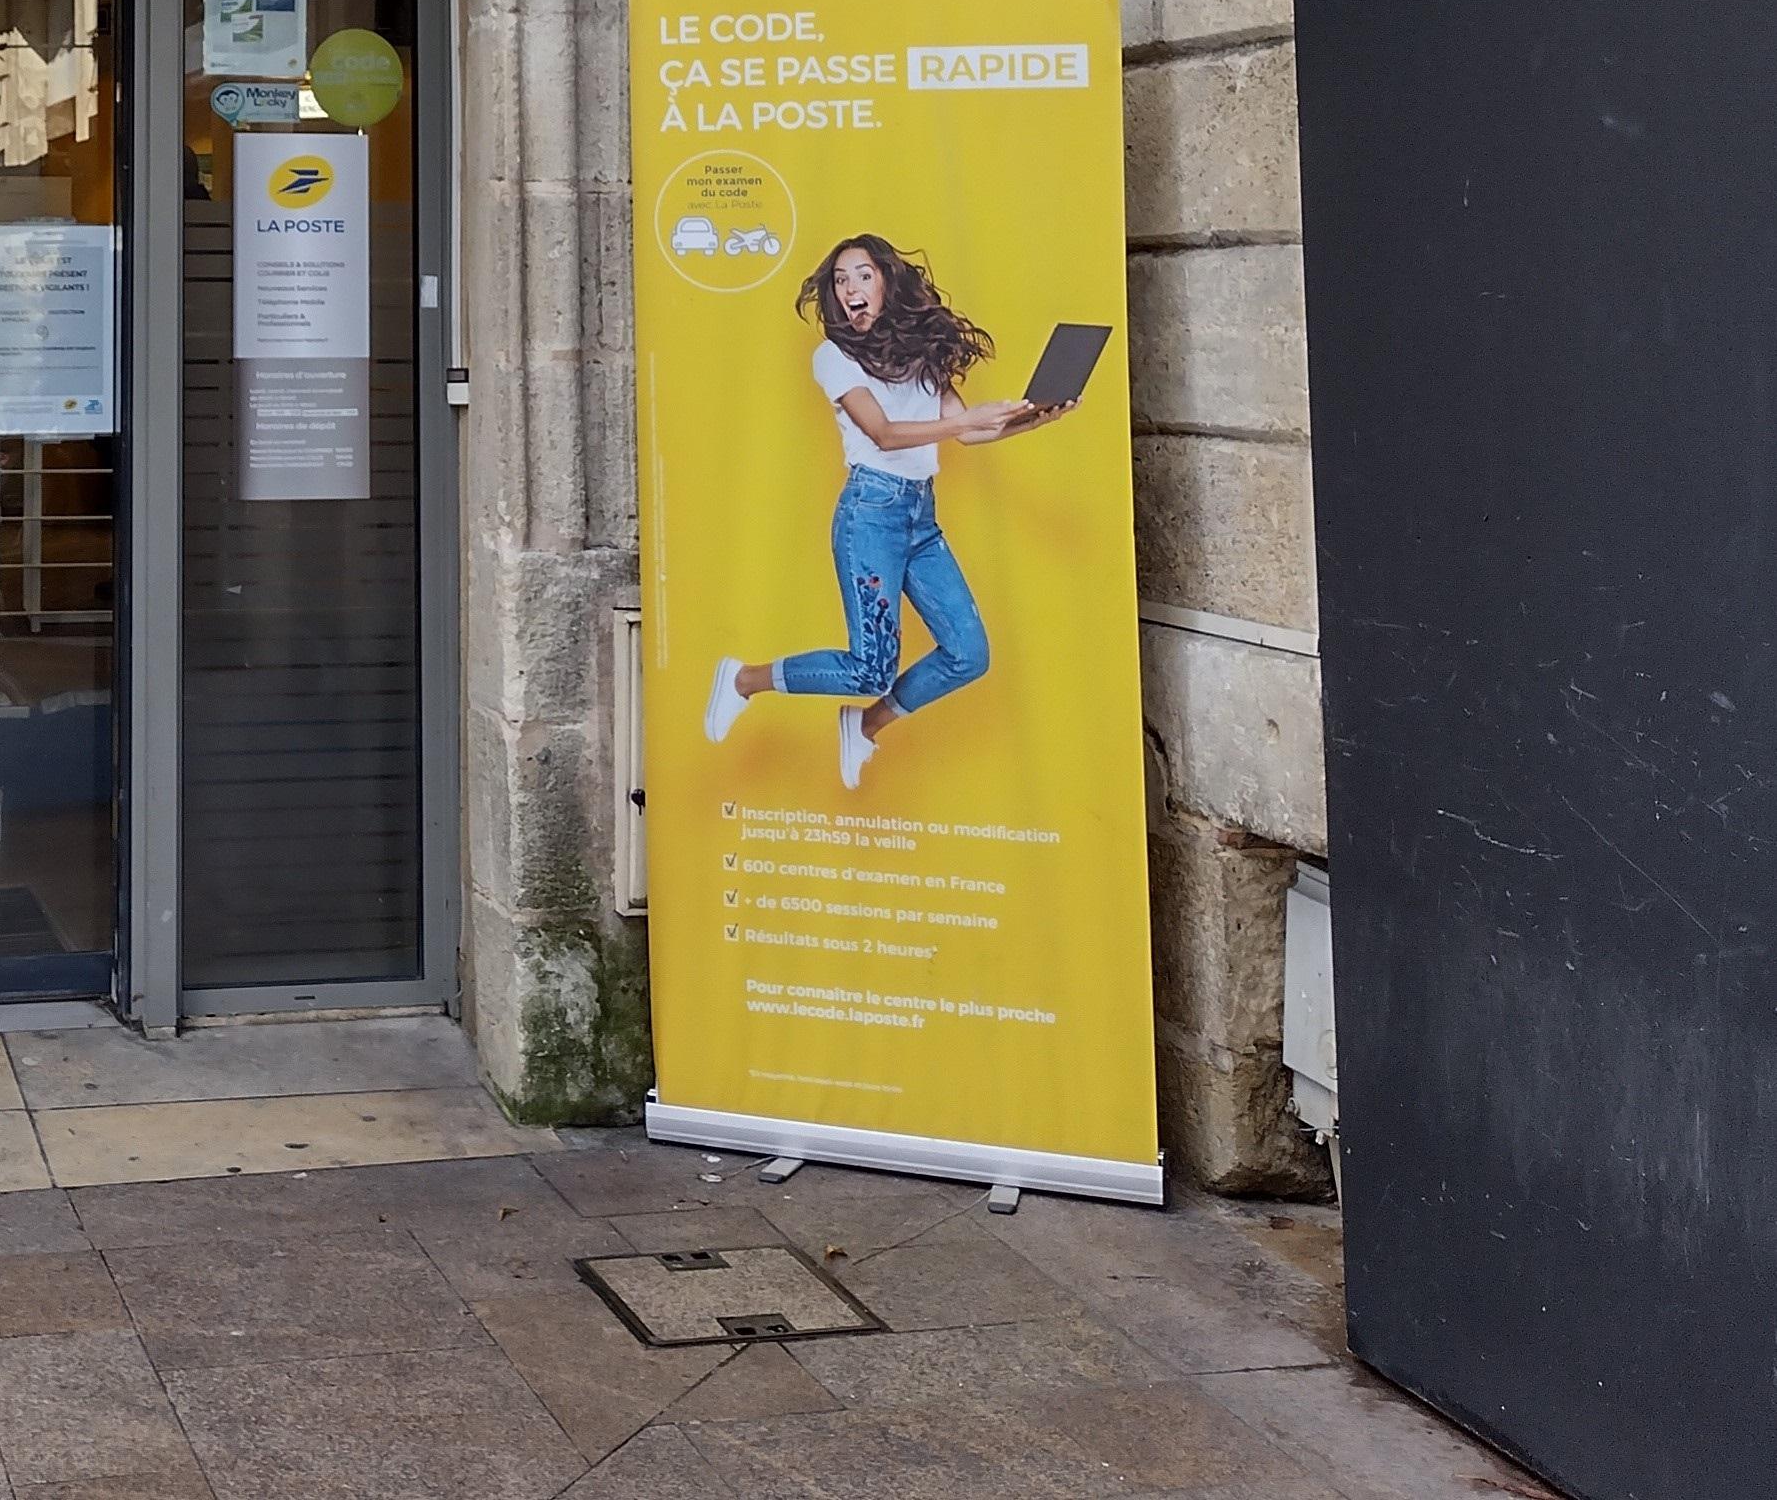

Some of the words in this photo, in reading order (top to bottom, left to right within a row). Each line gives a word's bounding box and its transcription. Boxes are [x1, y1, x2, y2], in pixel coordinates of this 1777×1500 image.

[659, 15, 701, 45] LE
[709, 11, 826, 44] CODE,
[658, 58, 713, 97] ÇA
[719, 57, 767, 87] SE
[776, 53, 898, 86] PASSE
[919, 51, 1080, 83] RAPIDE
[246, 87, 296, 100] Monkey
[253, 98, 287, 108] Lcky
[659, 96, 688, 133] À
[696, 101, 744, 132] LA
[752, 99, 884, 131] POSTE.
[686, 178, 712, 186] mon
[715, 176, 762, 186] examen
[704, 165, 743, 175] Passer
[700, 188, 716, 198] du
[718, 187, 748, 197] code
[731, 200, 763, 209] Poste
[256, 219, 281, 233] LA
[284, 219, 346, 233] POSTE
[740, 823, 800, 842] jusqu'à
[803, 827, 852, 846] 23h59
[855, 832, 871, 847] la
[873, 835, 917, 851] veille
[834, 815, 924, 833] annulation
[927, 821, 950, 835] ou
[953, 823, 1062, 844] modification
[742, 858, 775, 874] 600
[778, 863, 838, 880] centres
[841, 866, 921, 887] d'examen
[925, 875, 946, 888] en
[950, 875, 1007, 895] France
[755, 894, 777, 910] de
[780, 896, 823, 913] 6500
[825, 902, 892, 920] sessions
[895, 908, 924, 924] par
[926, 911, 999, 930] semaine
[744, 927, 820, 949] Résultats
[822, 937, 859, 953] sous
[862, 938, 873, 954] 2
[745, 978, 784, 995] Pour
[785, 984, 863, 1004] connaître
[865, 989, 881, 1005] le
[883, 995, 937, 1012] centre
[939, 997, 956, 1013] le
[957, 1000, 994, 1018] plus
[997, 1005, 1057, 1025] proche
[745, 999, 926, 1029] www.lecode.laposte.fr
